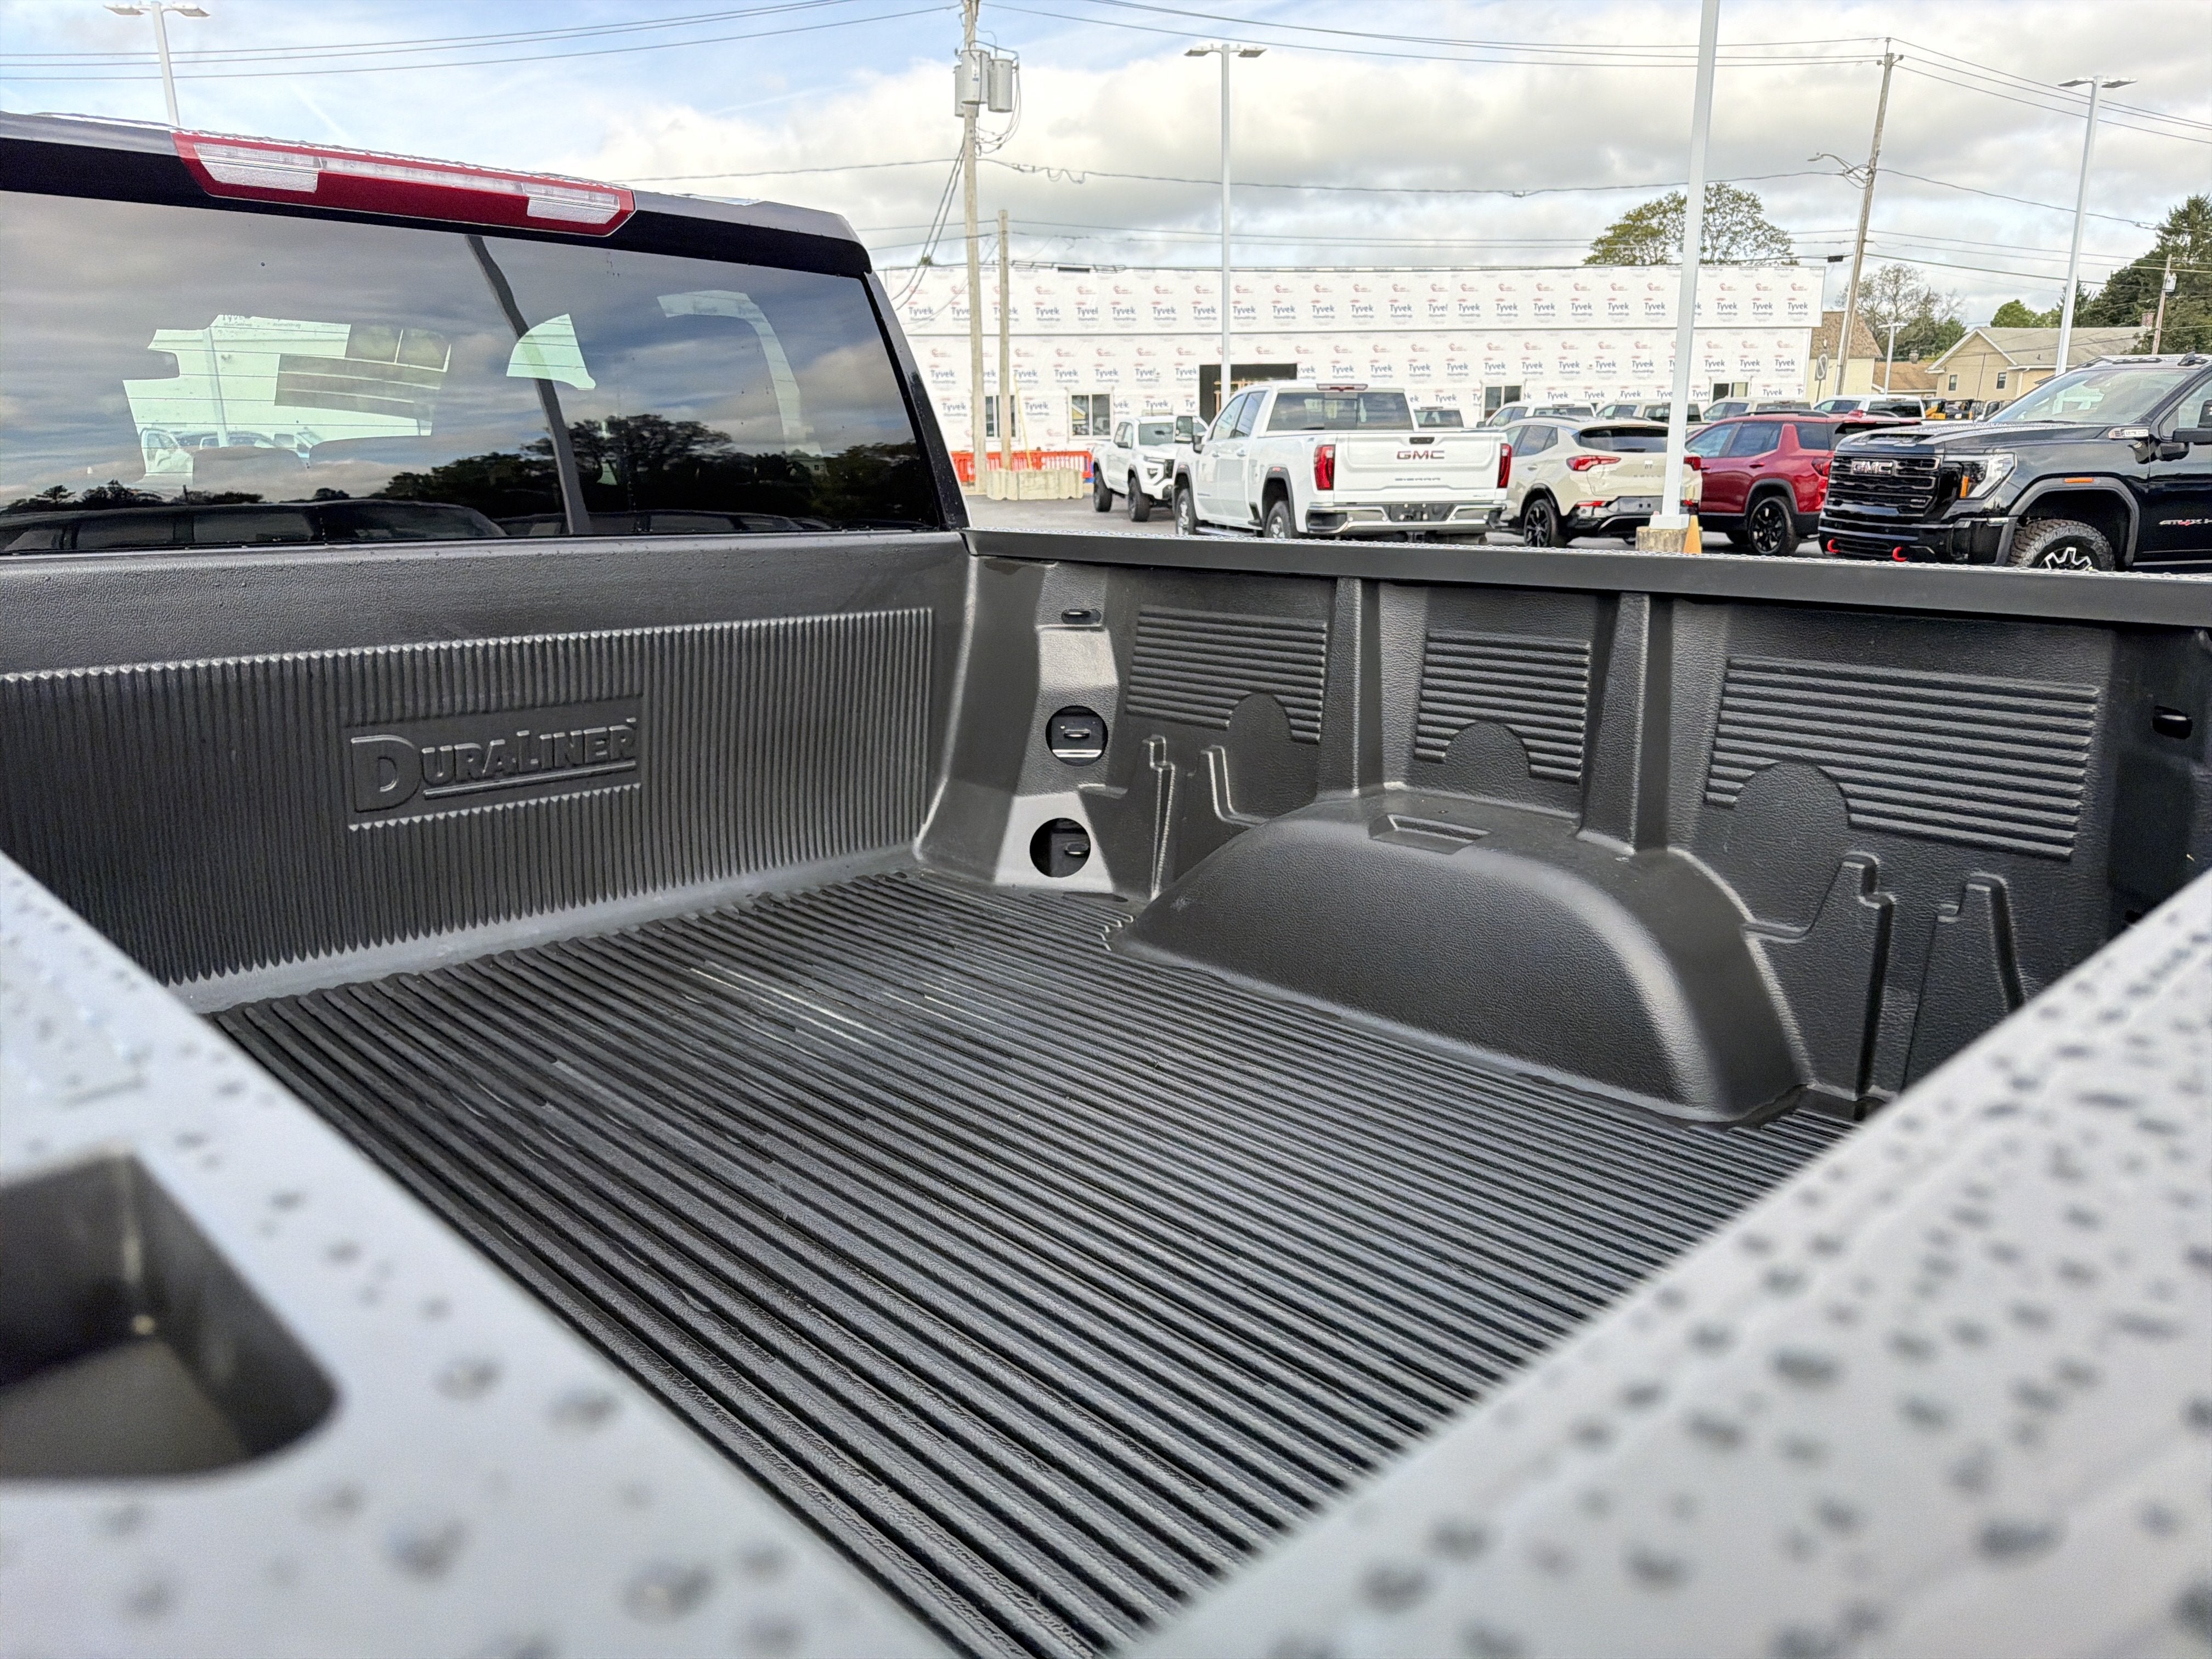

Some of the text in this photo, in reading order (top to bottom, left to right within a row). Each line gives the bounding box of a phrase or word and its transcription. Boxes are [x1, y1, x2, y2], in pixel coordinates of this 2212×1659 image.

[1272, 305, 1295, 315] Tyvek
[1312, 305, 1334, 314] Tyvek
[1351, 304, 1373, 314] Tyvek
[1390, 304, 1412, 313] Tyvek
[1459, 303, 1480, 313] Tyvek
[1496, 303, 1518, 312] Tyvek
[1534, 303, 1555, 312] Tyvek
[1571, 303, 1592, 312] Tyvek
[1608, 302, 1629, 311] Tyvek
[1645, 302, 1666, 311] Tyvek
[1717, 302, 1737, 311] Tyvek
[1752, 302, 1773, 311] Tyvek
[1788, 302, 1808, 311] Tyvek
[951, 307, 970, 316] Tyve
[1447, 363, 1468, 372] Tyvek
[1485, 362, 1505, 371] Tyvek
[1522, 361, 1543, 370] Tyvek
[1559, 361, 1580, 370] Tyvek
[1596, 360, 1616, 369] Tyvek
[1632, 360, 1654, 369] Tyvek
[1705, 359, 1725, 368] Tyvek
[1740, 359, 1760, 368] Tyvek
[1775, 358, 1795, 368] Tyvek
[1332, 365, 1353, 374] Tyvek
[1371, 364, 1392, 373] Tyvek
[1409, 364, 1430, 373] Tyvek
[1547, 392, 1568, 400] Tyvek
[1584, 391, 1605, 399] Tyvek
[1620, 390, 1641, 399] Tyvek
[1657, 390, 1672, 400] Tyve
[1763, 388, 1782, 397] Tyvek
[1435, 394, 1457, 403] Tyvek
[1397, 450, 1444, 460] GMC
[1853, 461, 1893, 475] GMC
